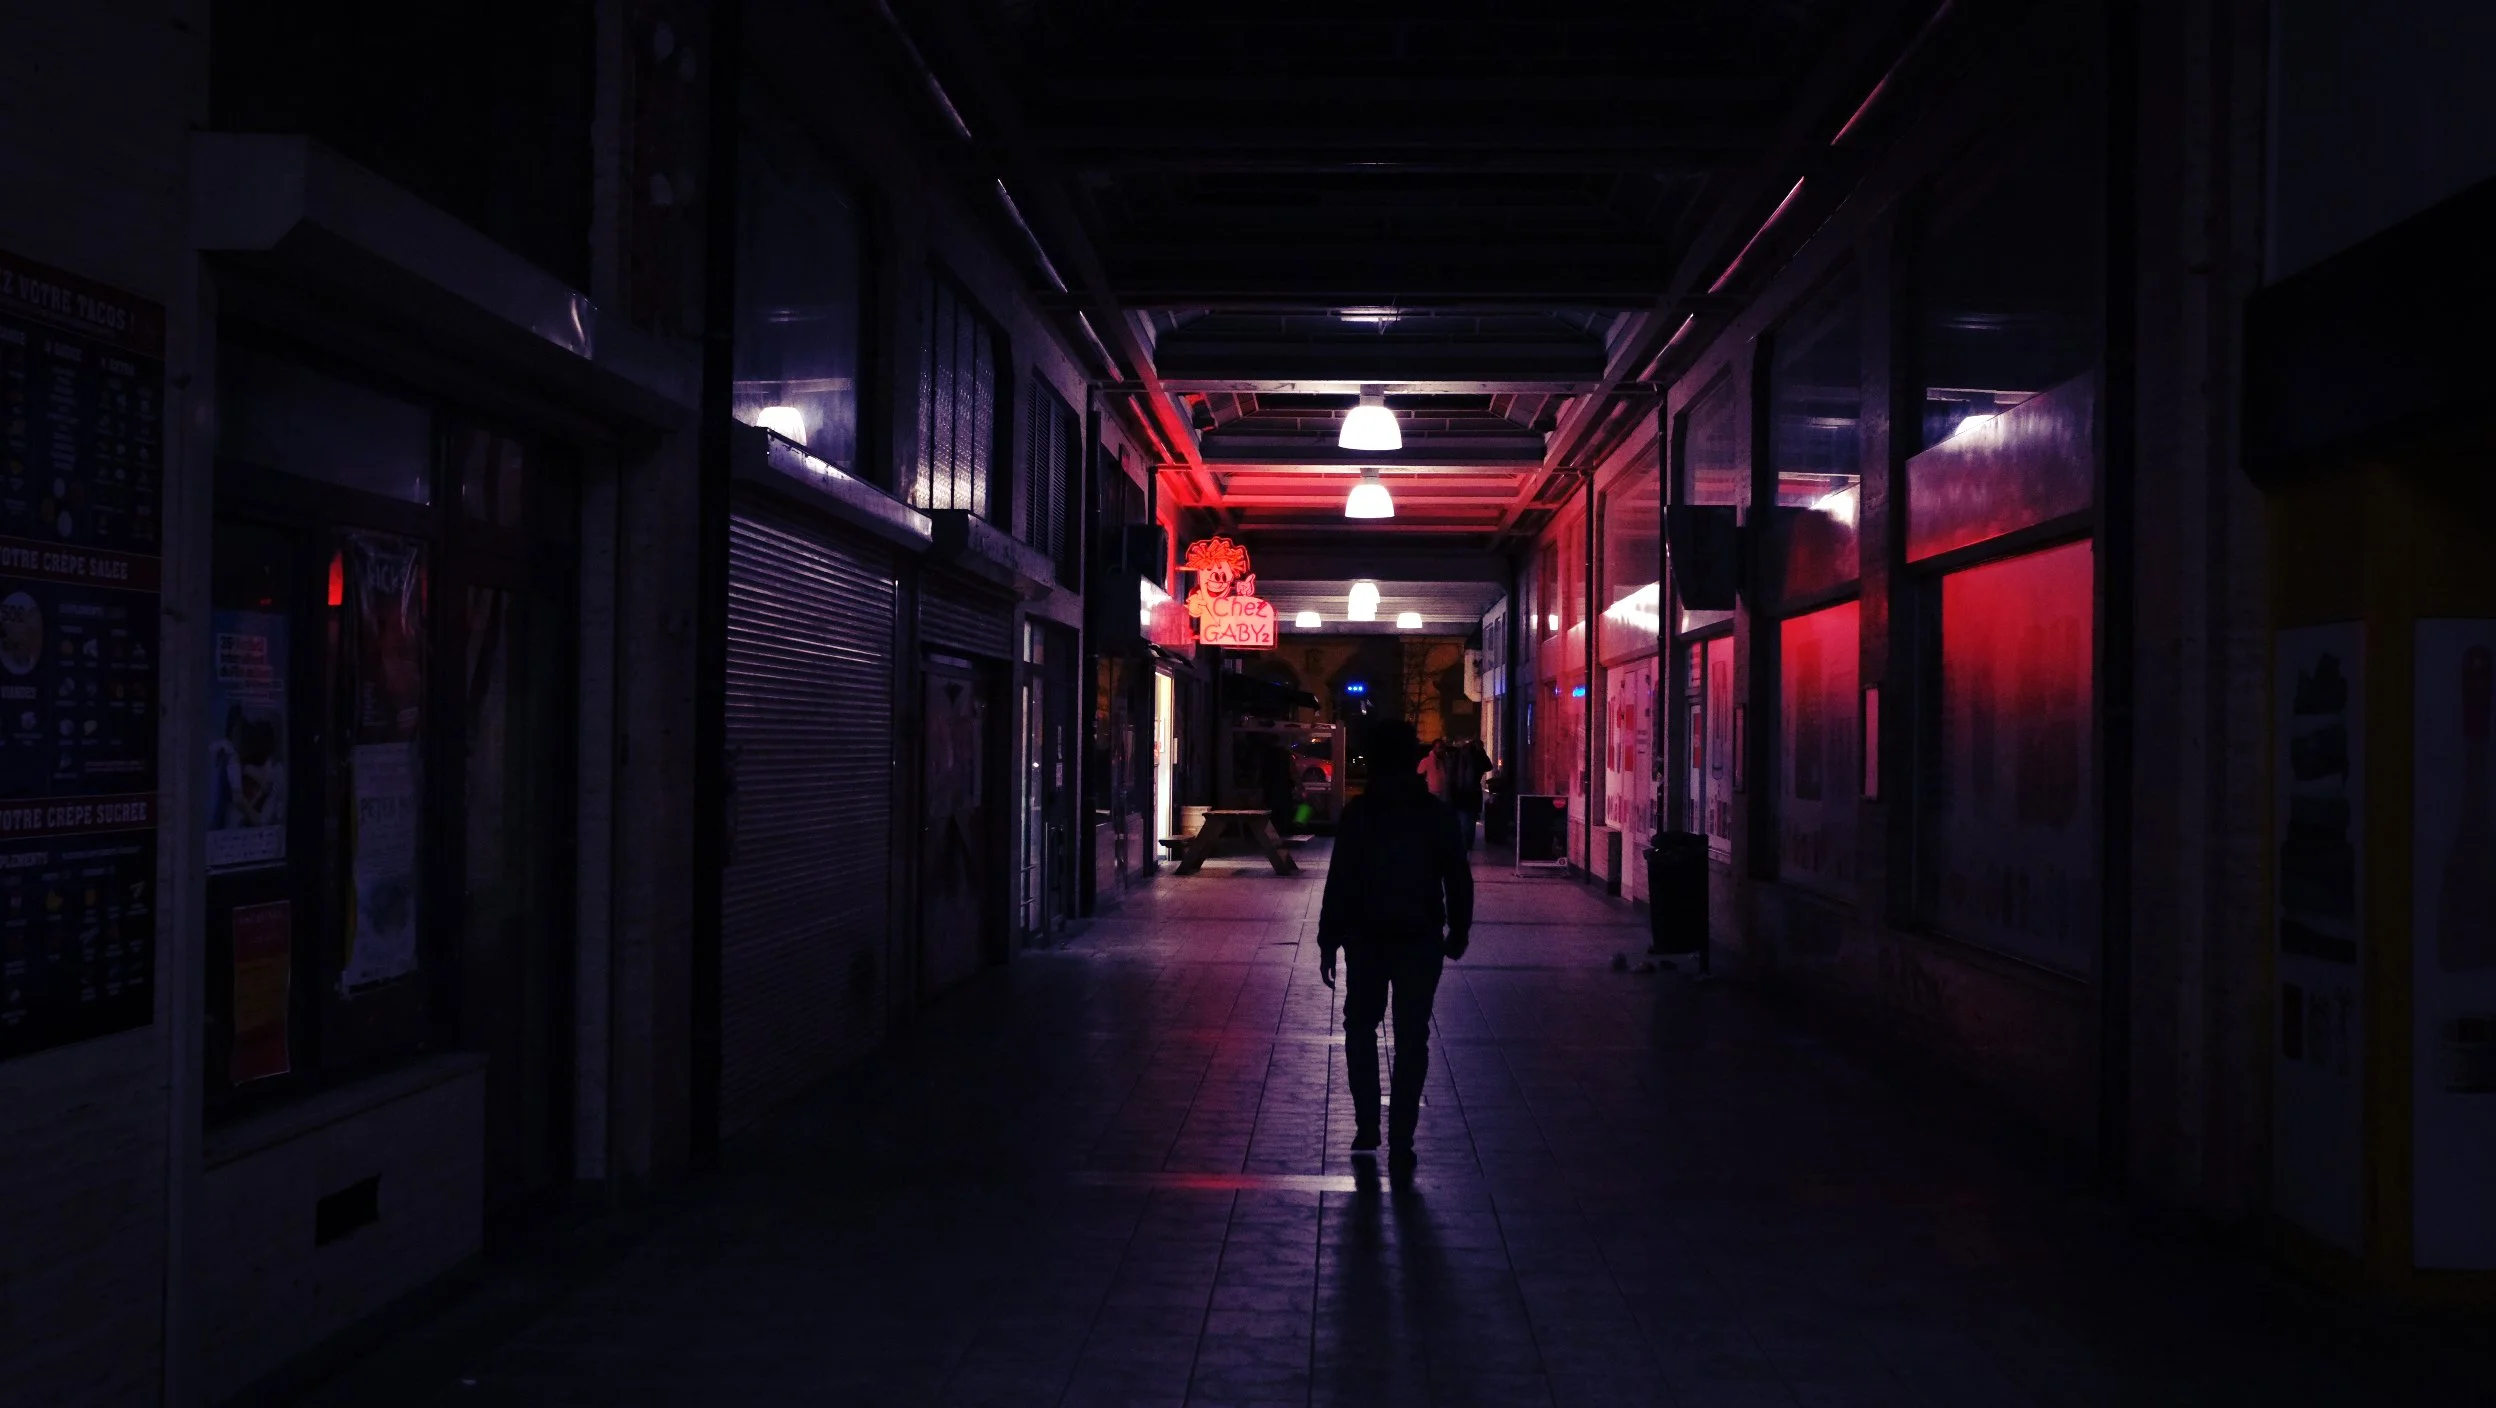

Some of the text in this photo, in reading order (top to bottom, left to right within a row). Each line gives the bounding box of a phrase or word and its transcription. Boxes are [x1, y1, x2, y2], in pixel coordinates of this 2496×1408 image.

[18, 275, 73, 314] VOTRE
[77, 294, 126, 331] TACOS
[0, 546, 39, 570] OTRE
[1213, 598, 1267, 618] Chez
